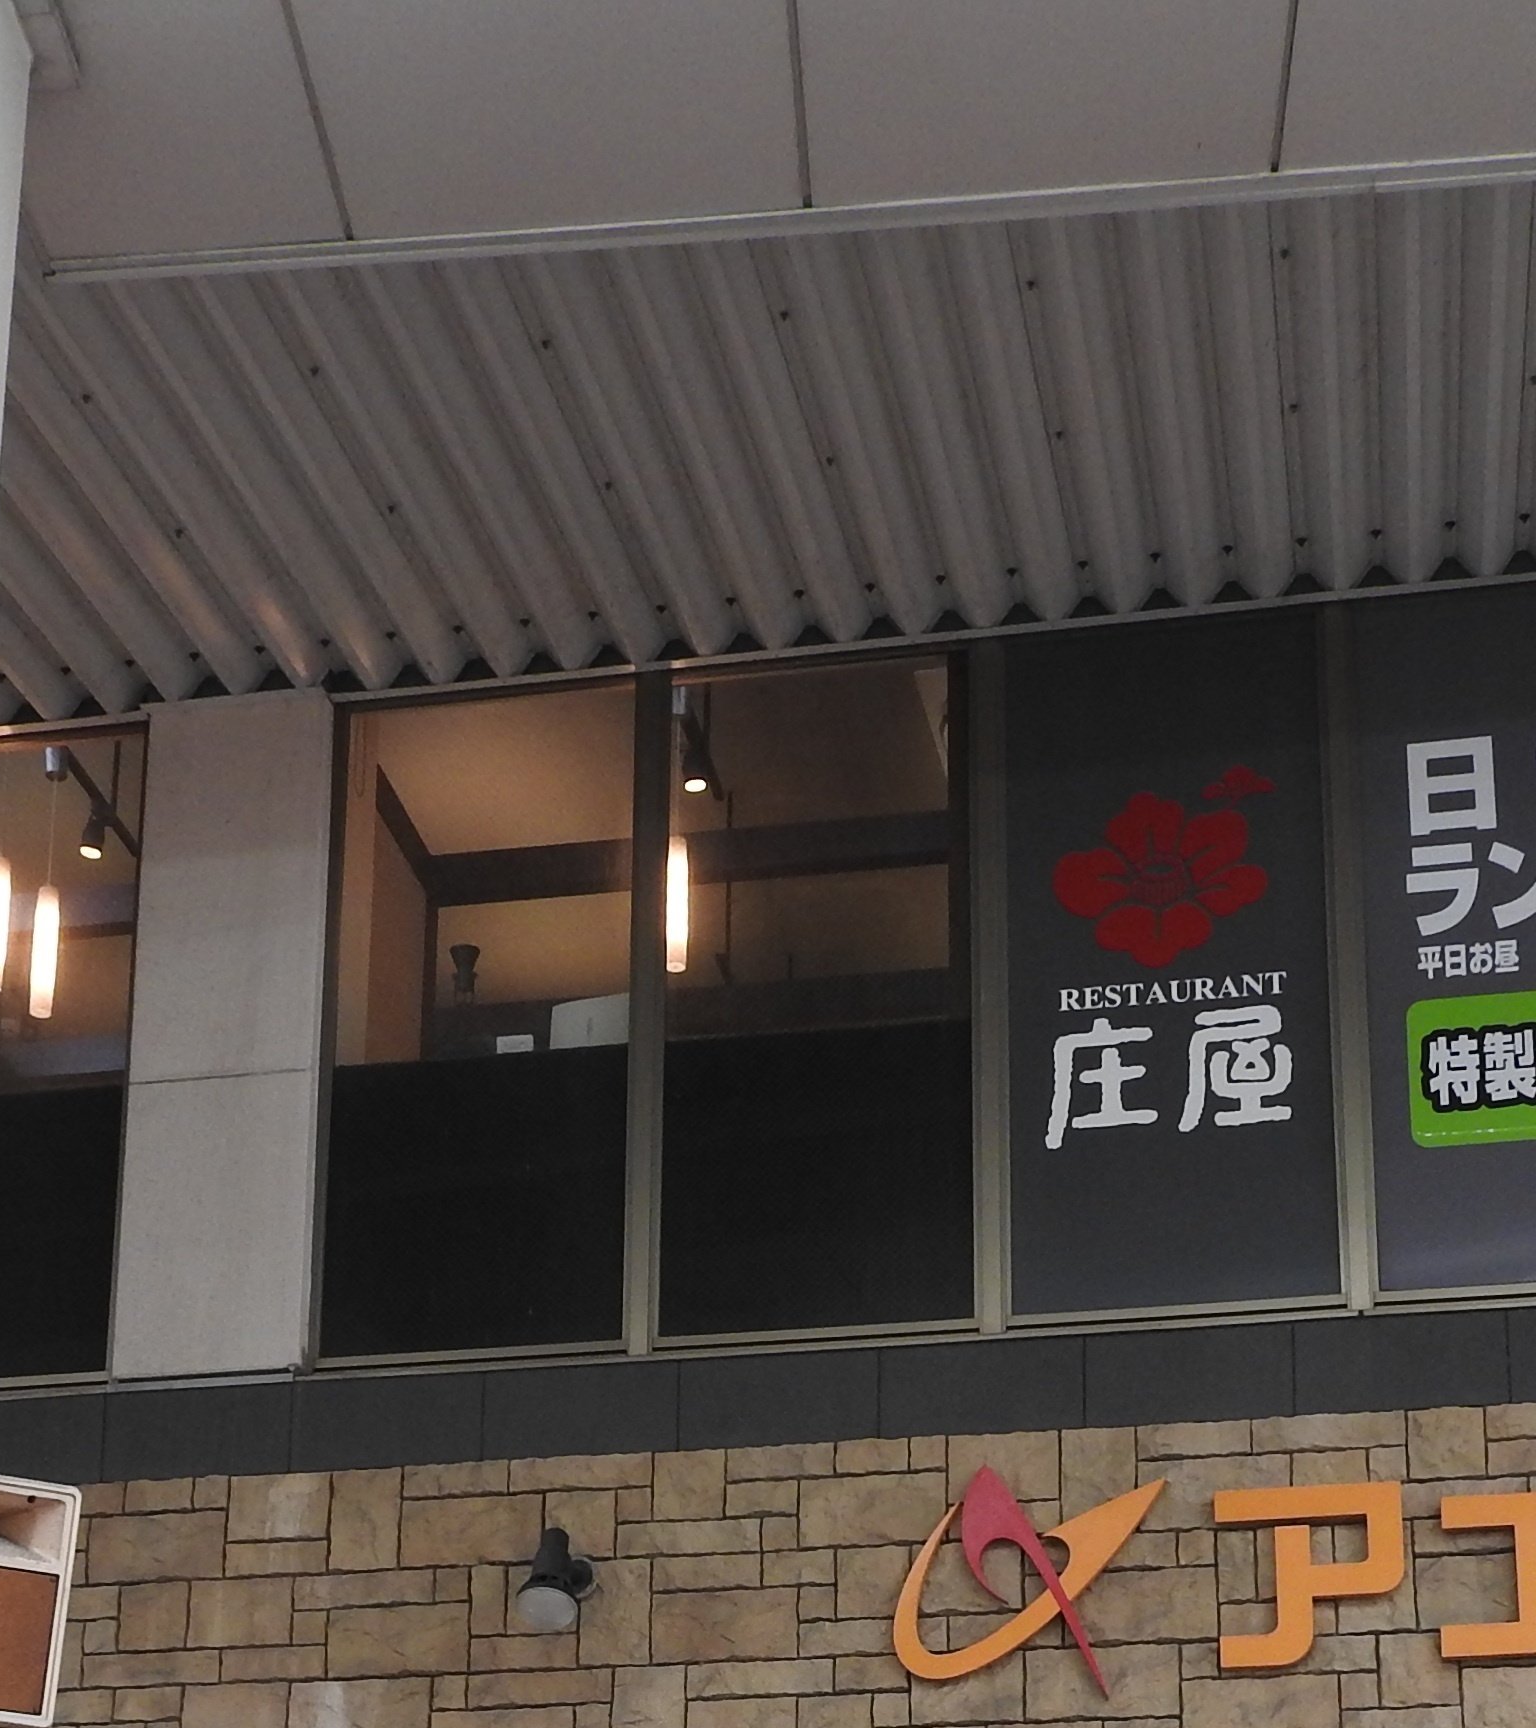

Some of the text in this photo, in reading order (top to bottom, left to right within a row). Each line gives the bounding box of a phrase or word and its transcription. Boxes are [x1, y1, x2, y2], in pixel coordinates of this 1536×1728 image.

[1416, 938, 1520, 980] 平日お昼
[1058, 971, 1288, 1012] RESTAURANT
